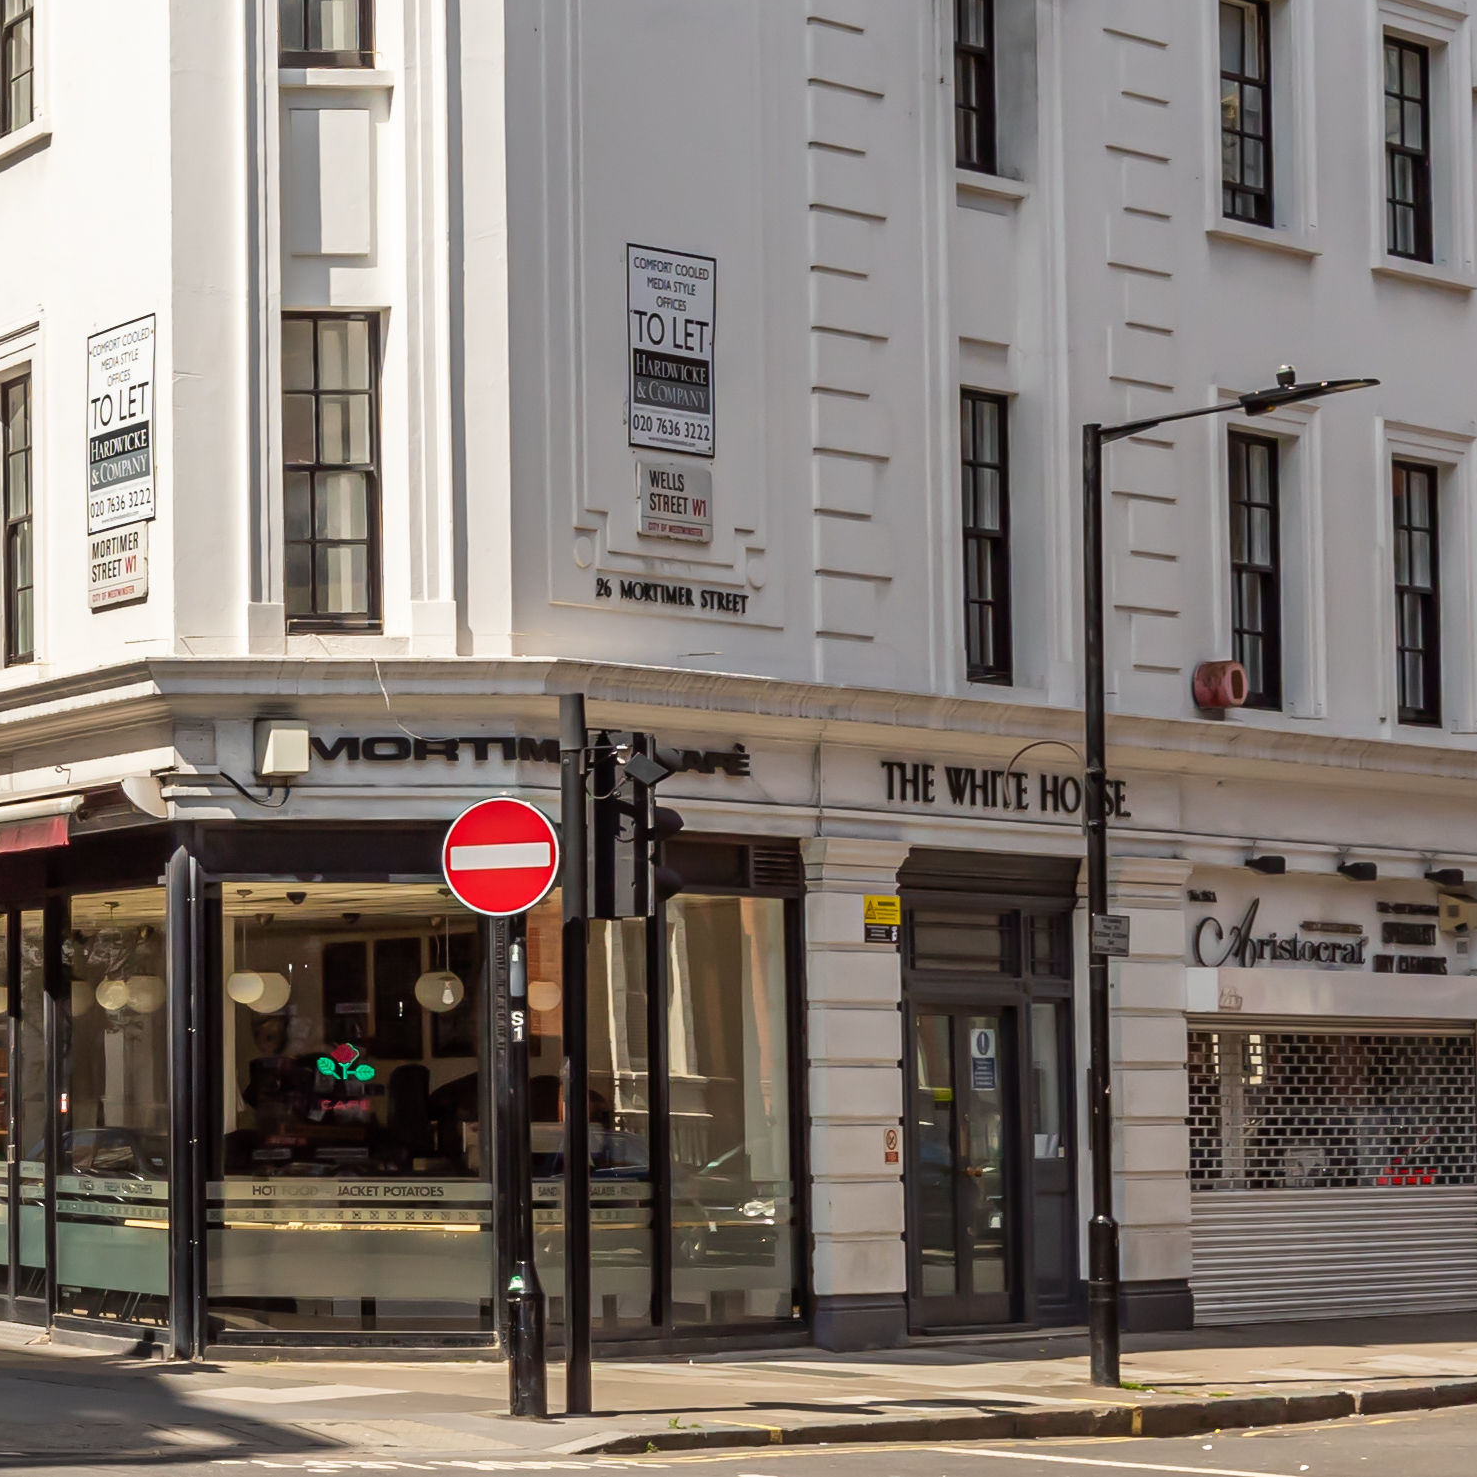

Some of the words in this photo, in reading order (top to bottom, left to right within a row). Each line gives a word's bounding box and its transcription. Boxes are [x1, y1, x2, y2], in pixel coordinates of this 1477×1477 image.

[634, 257, 673, 274] COMFORT
[675, 264, 709, 281] COOLED
[647, 276, 672, 292] MEDIA
[673, 281, 696, 296] STYLE
[656, 296, 686, 311] OFFICES
[633, 309, 665, 346] TO
[673, 316, 709, 353] LET
[636, 353, 707, 385] HARDWICKE
[90, 394, 113, 430] TO
[119, 381, 149, 421] LET
[636, 381, 647, 399] &
[649, 380, 707, 409] COMPANY
[632, 414, 653, 432] 020
[656, 417, 681, 437] 7636
[684, 421, 711, 441] 3222
[91, 428, 148, 462] HARDWICKE
[91, 469, 99, 486] &
[100, 453, 148, 483] COMPANY
[649, 469, 685, 492] WELLS
[90, 500, 104, 518] 020
[107, 494, 126, 514] 7636
[128, 487, 152, 508] 3222
[649, 493, 689, 515] STREET
[692, 498, 707, 517] W1
[91, 531, 139, 560] MORTIMER
[91, 558, 123, 583] STREET
[124, 554, 137, 574] W1
[595, 577, 612, 598] 26
[620, 579, 695, 607] MORTIMER
[700, 590, 749, 614] STREET
[881, 761, 936, 803] THE
[944, 766, 1029, 811] WHITE
[1040, 773, 1132, 818] HOSE
[1195, 897, 1367, 968] Aristocrat
[252, 1185, 277, 1196] HOT
[281, 1185, 318, 1196] FOOD
[337, 1185, 380, 1197] JACKET
[383, 1185, 444, 1197] POTATOES
